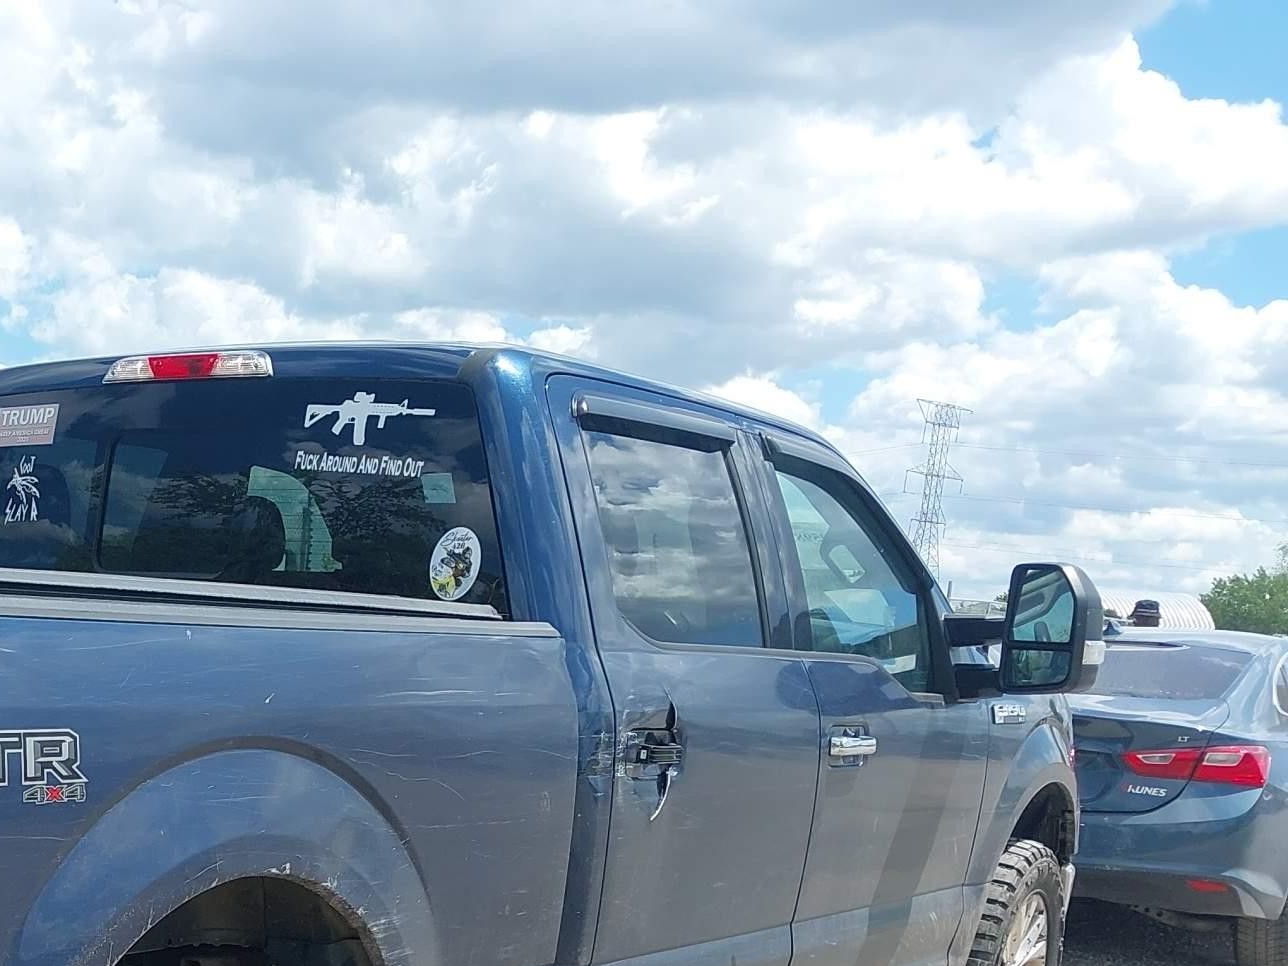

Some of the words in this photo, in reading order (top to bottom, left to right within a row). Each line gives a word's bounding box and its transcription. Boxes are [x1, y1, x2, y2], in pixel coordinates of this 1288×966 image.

[1, 407, 55, 426] TRUMP
[294, 450, 320, 471] FUCK
[318, 451, 358, 473] AROUND
[356, 454, 379, 475] AND
[379, 455, 403, 477] FIND
[403, 457, 425, 478] OUT
[1127, 784, 1168, 797] KUNES
